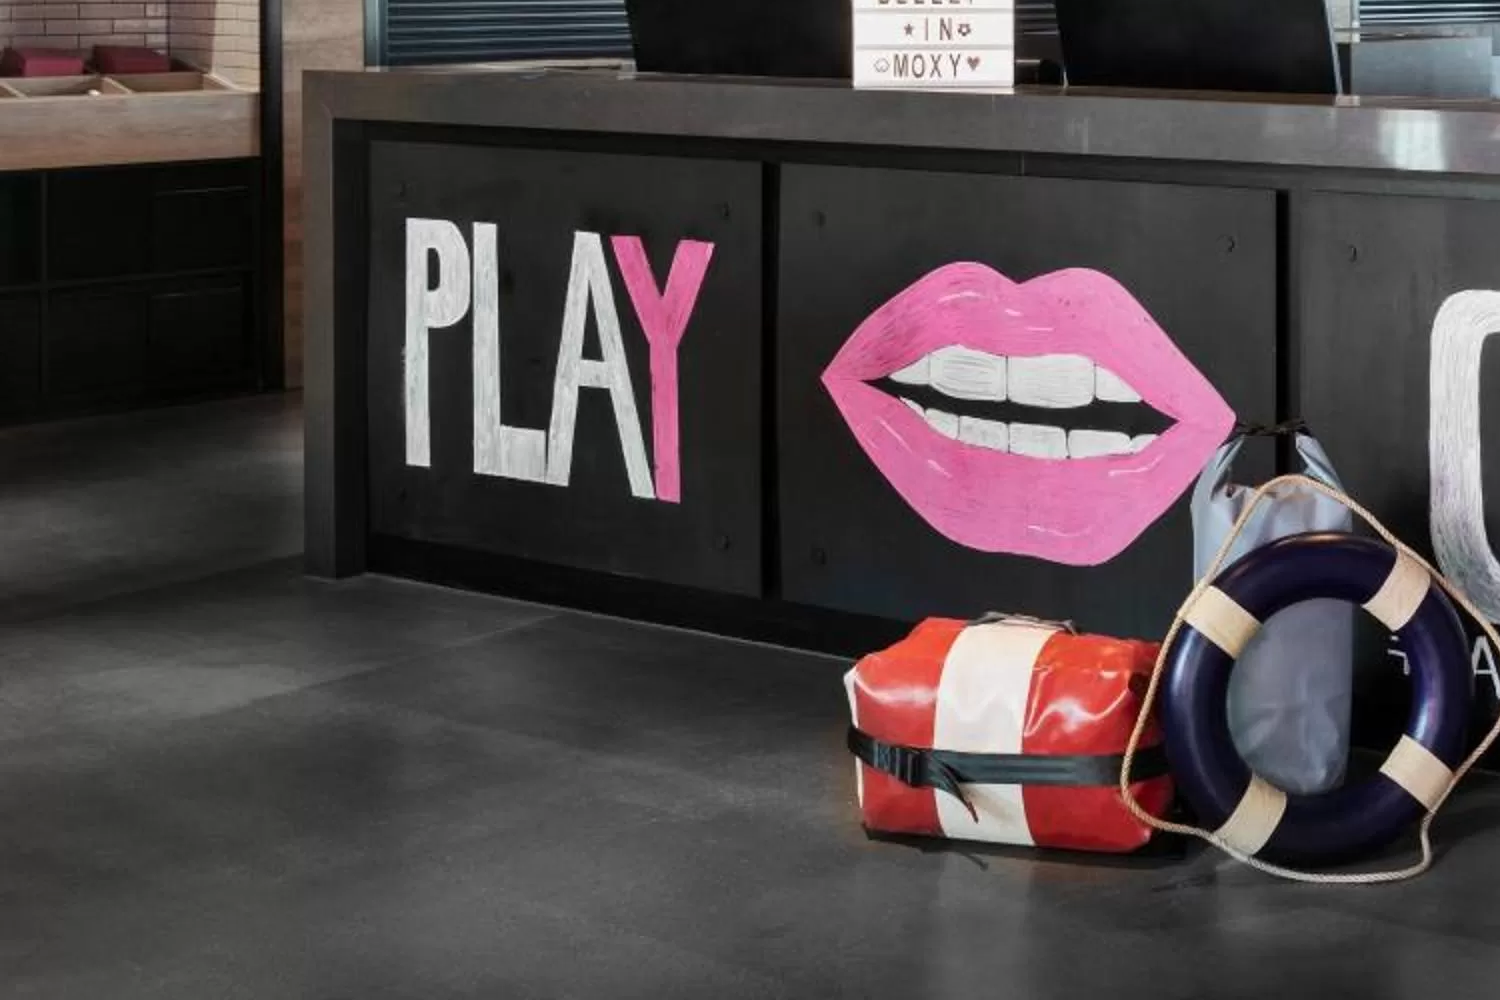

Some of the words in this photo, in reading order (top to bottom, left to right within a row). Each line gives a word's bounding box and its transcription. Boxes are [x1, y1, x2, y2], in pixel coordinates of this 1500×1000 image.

[924, 17, 953, 41] IN
[893, 54, 961, 78] MOXY
[405, 217, 715, 505] PLAY
